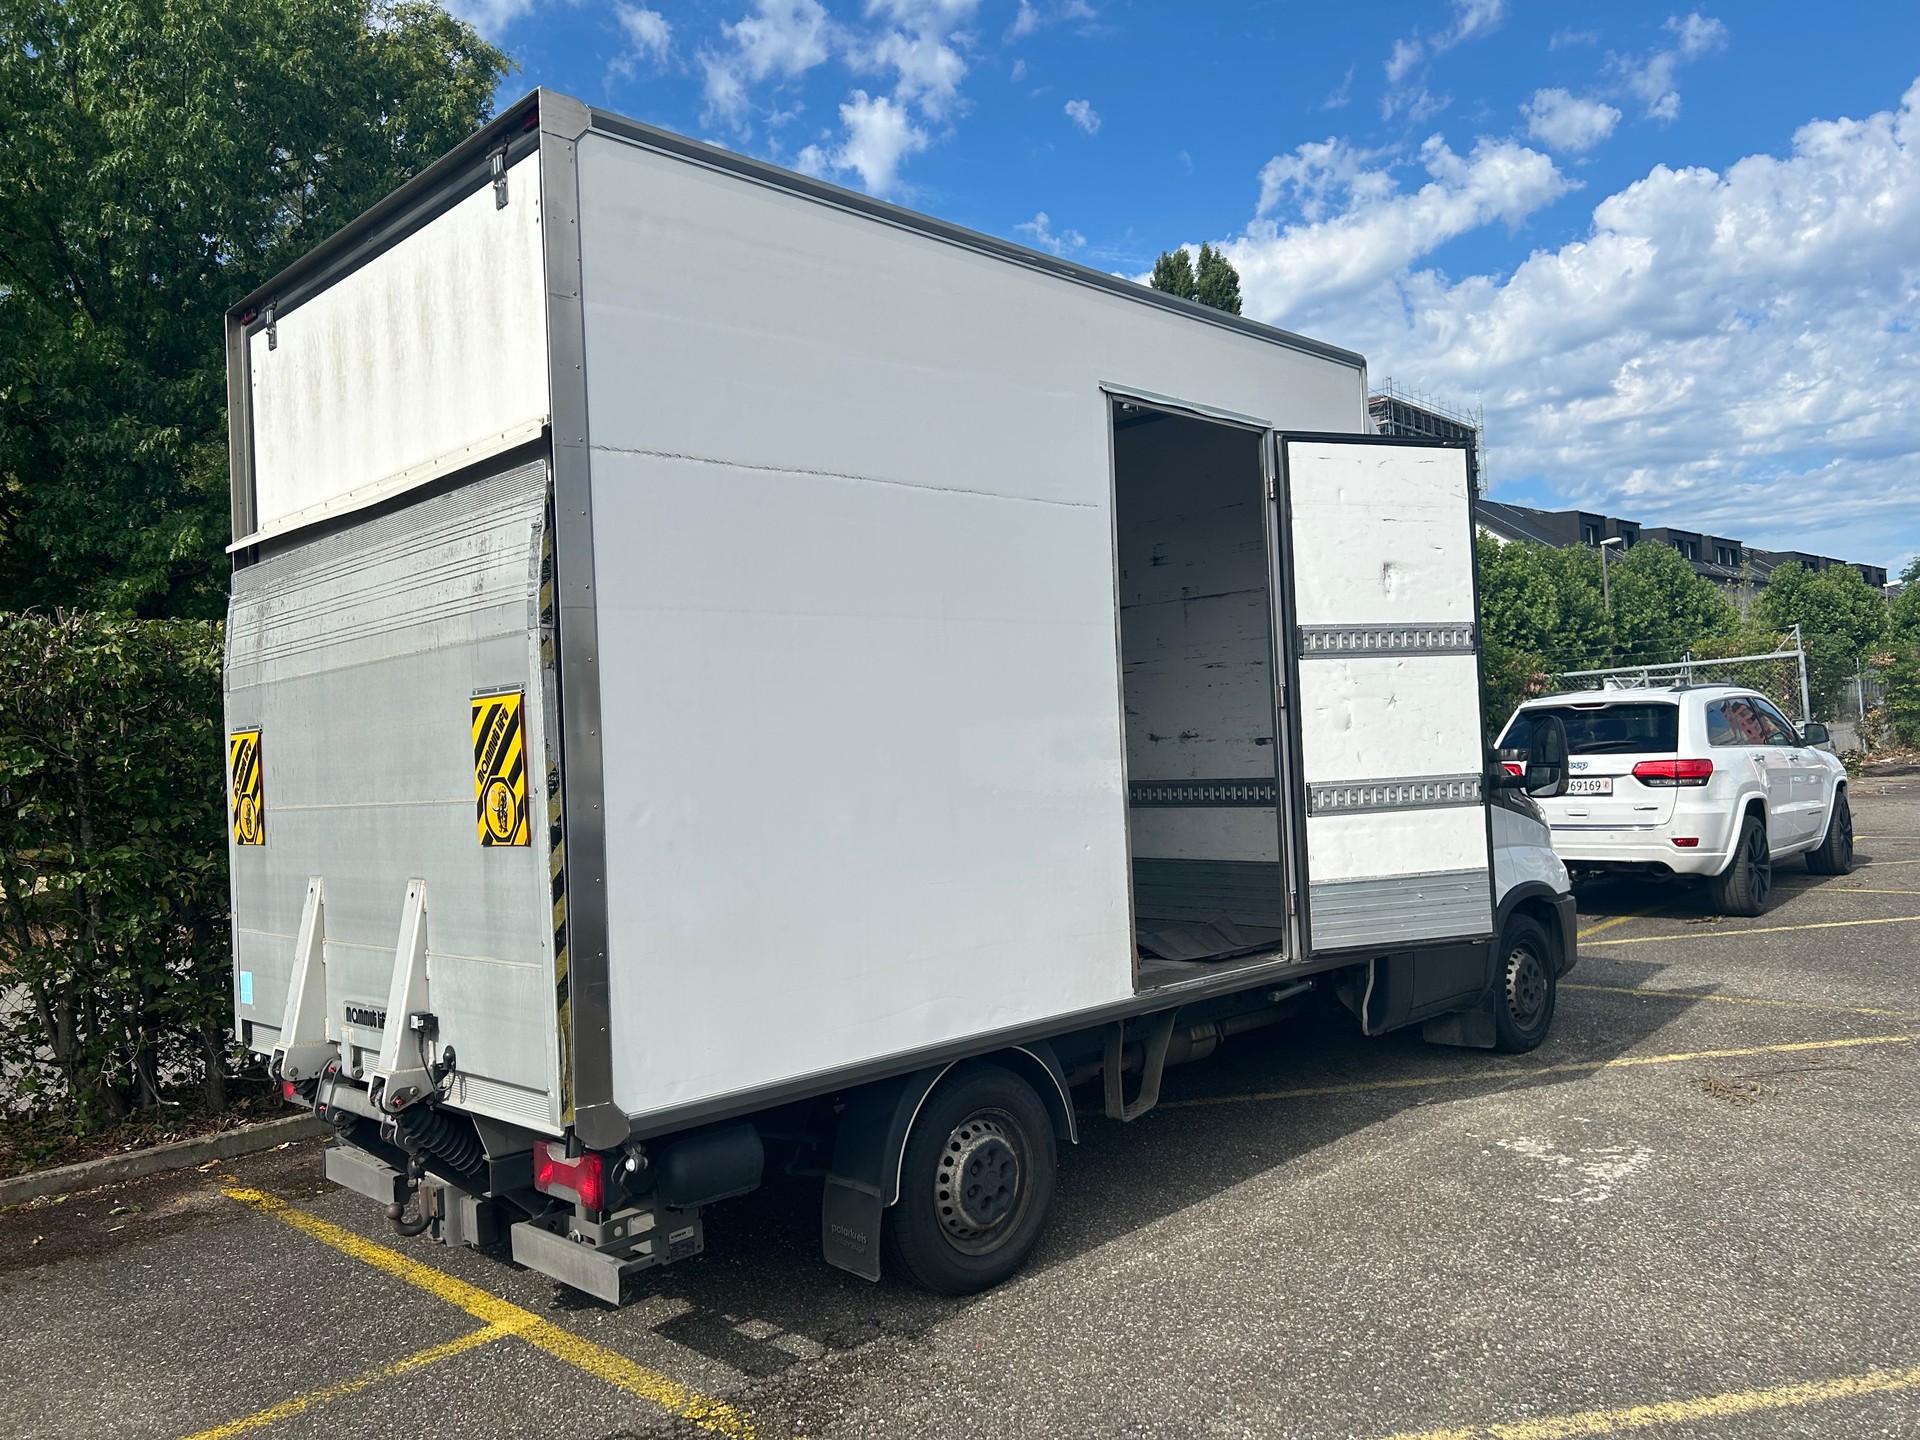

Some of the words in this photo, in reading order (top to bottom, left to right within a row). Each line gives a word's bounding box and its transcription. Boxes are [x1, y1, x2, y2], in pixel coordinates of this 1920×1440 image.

[1569, 761, 1588, 770] eep
[1570, 780, 1601, 791] 69169
[377, 1010, 387, 1030] lif
